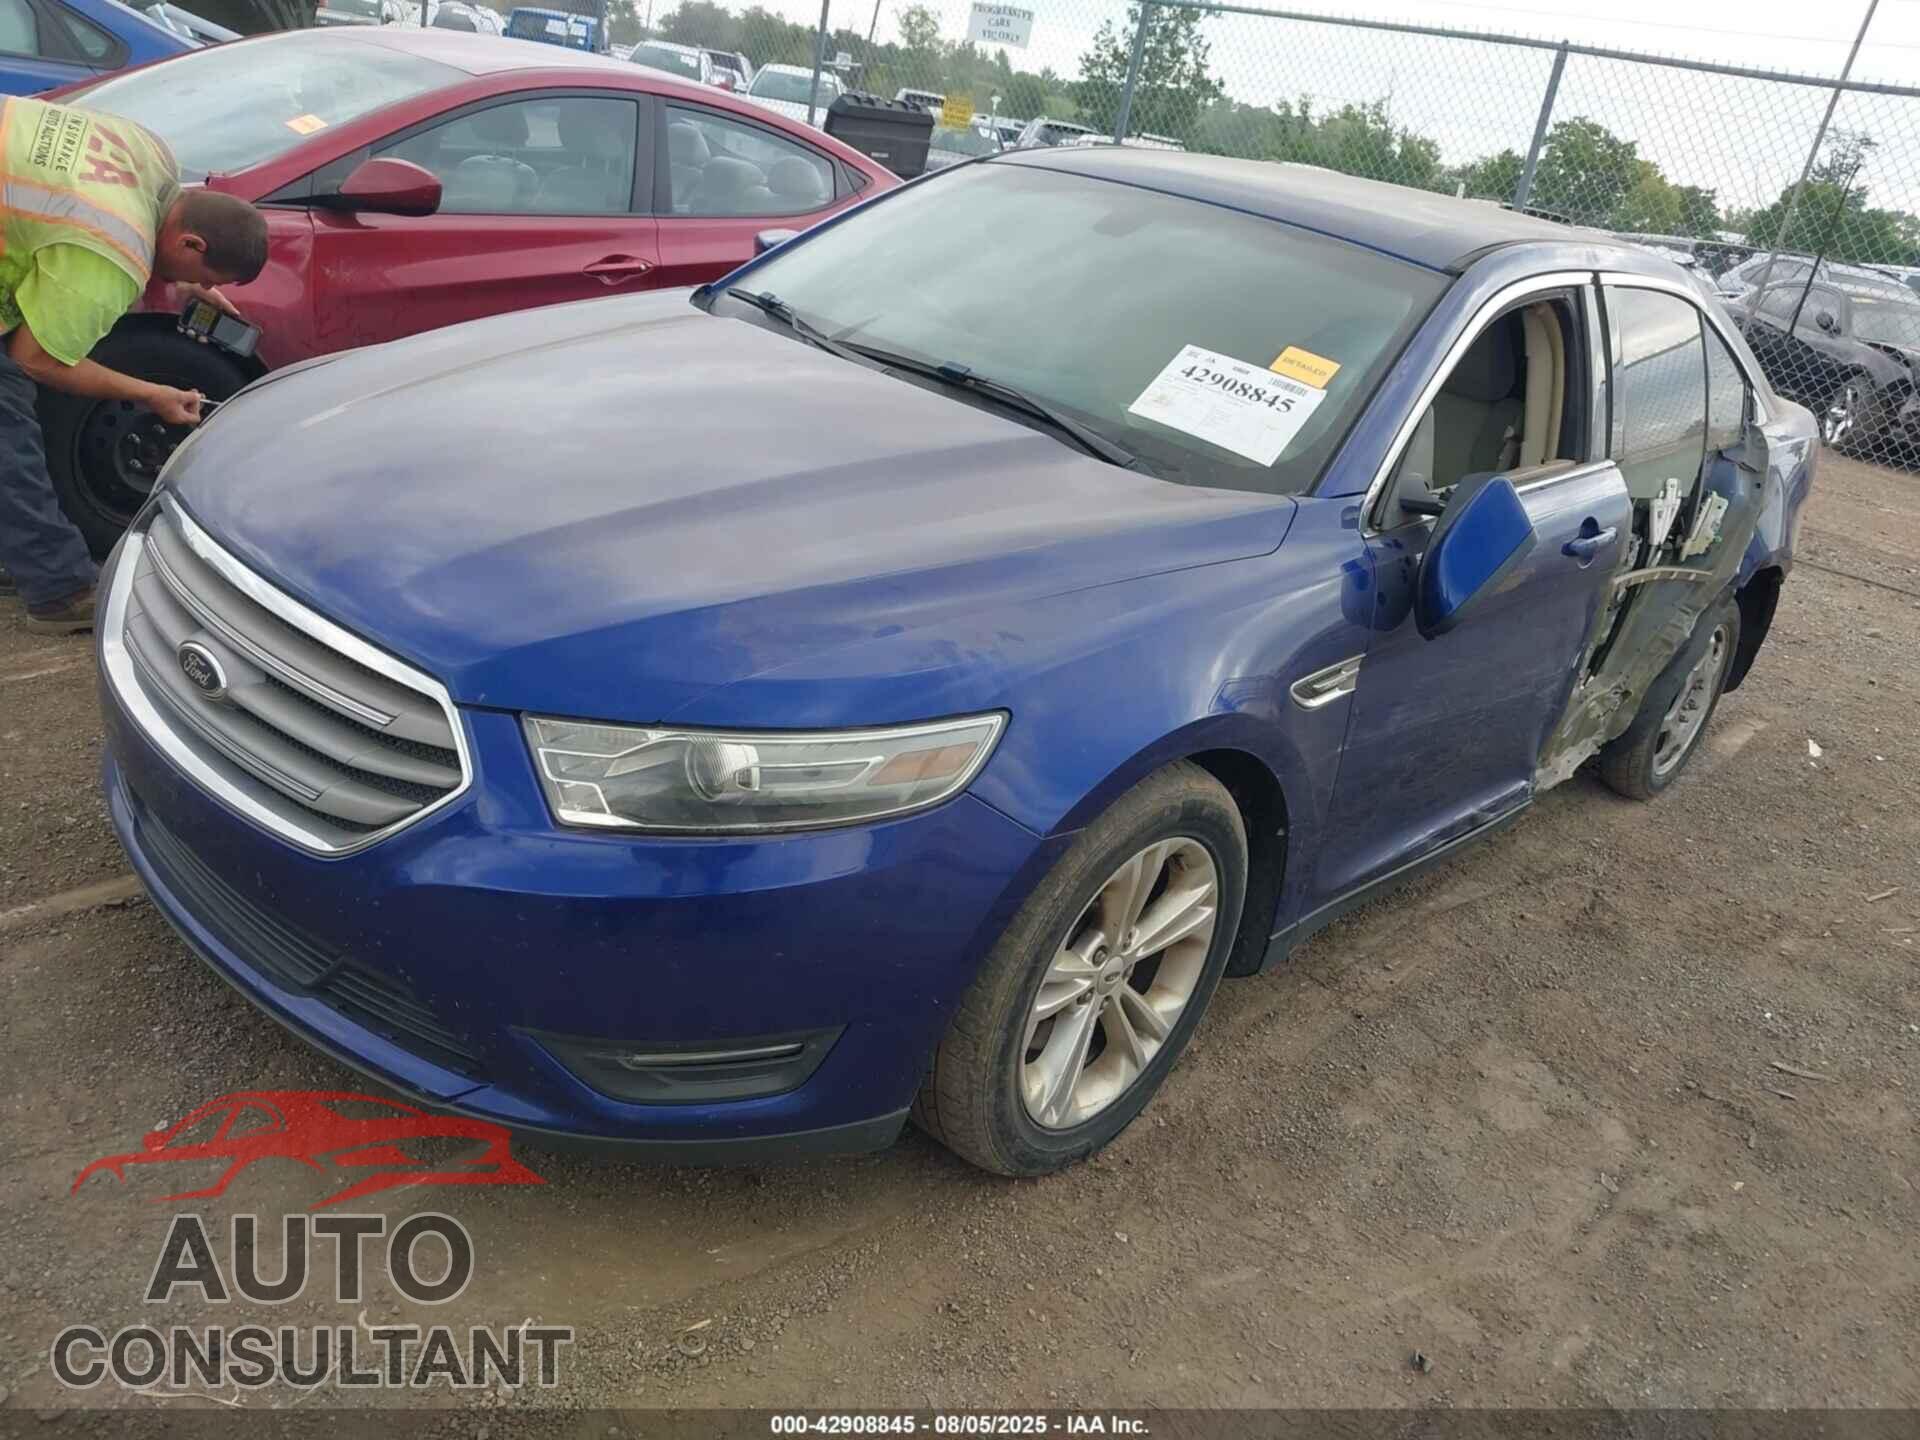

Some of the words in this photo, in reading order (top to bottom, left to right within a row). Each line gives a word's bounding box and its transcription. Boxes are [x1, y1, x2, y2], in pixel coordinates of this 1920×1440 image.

[988, 17, 1010, 27] CARS
[33, 126, 57, 167] AUCTIONS
[55, 112, 84, 171] INSURANCE
[1282, 356, 1328, 377] DETAILED
[1181, 365, 1296, 413] 42908845
[183, 652, 210, 687] Ford
